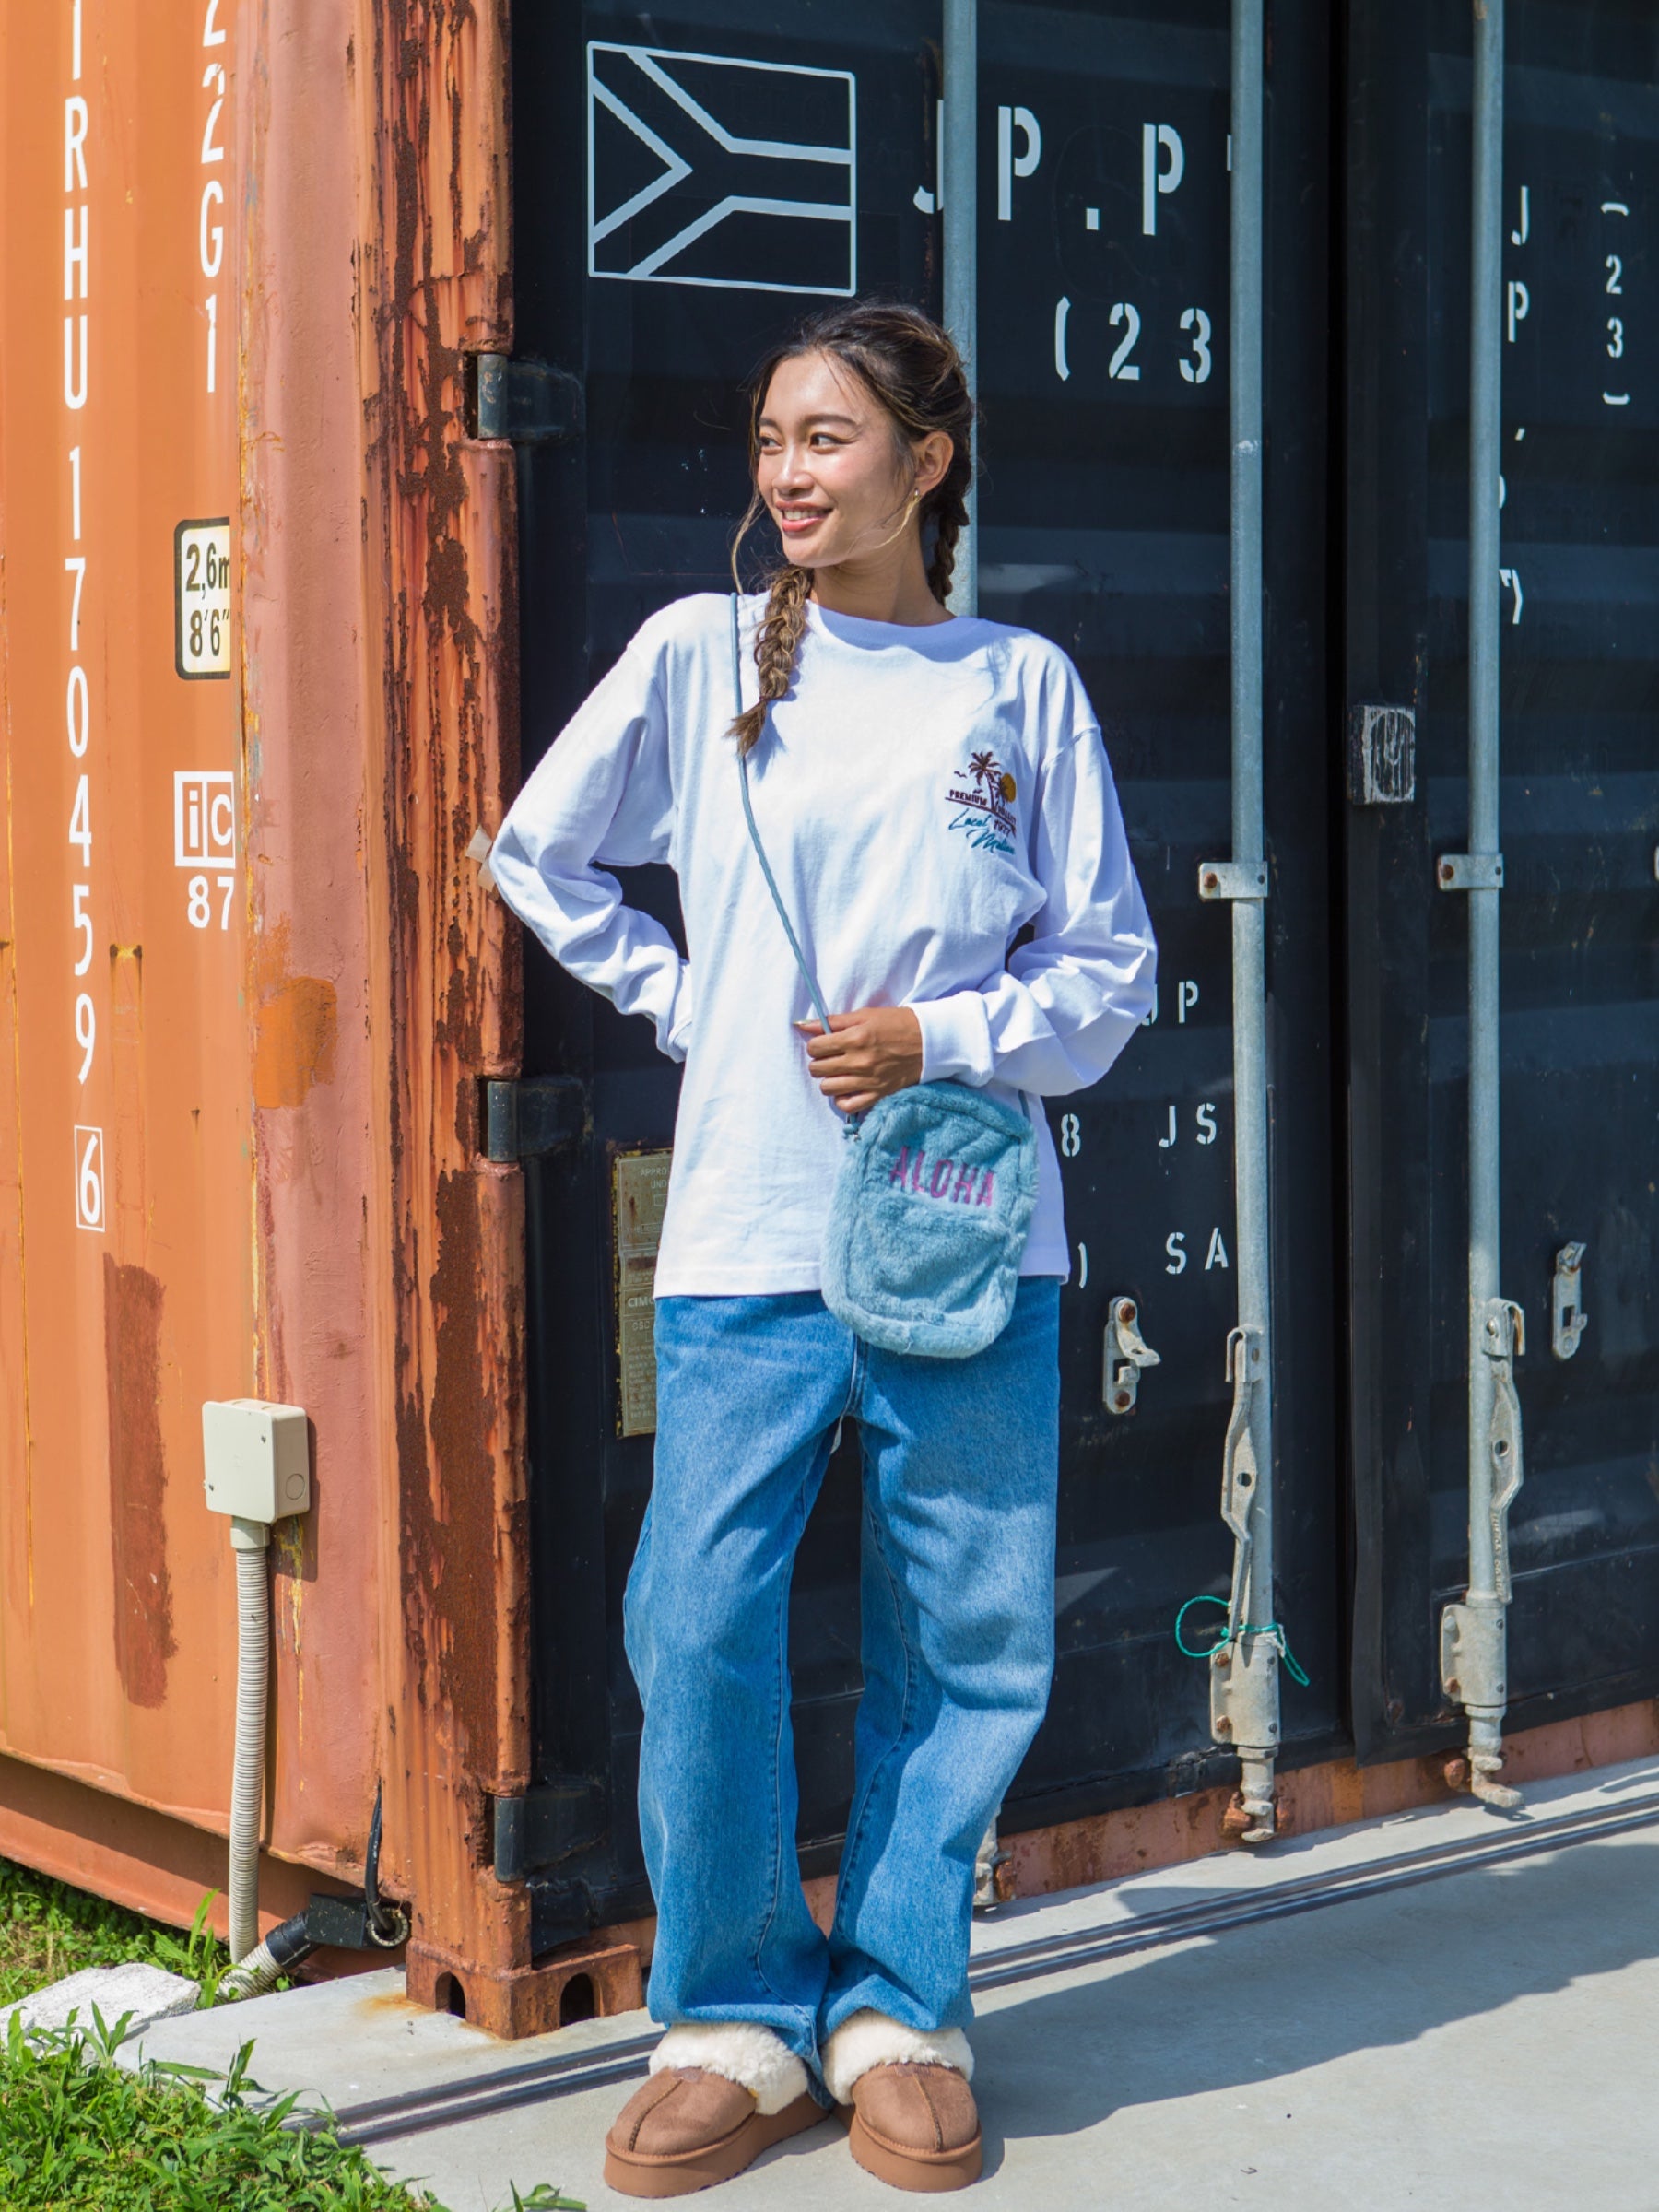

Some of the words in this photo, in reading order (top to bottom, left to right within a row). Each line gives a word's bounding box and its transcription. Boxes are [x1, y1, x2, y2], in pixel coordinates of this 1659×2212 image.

[65, 447, 96, 1085] 170459
[187, 875, 235, 931] 87
[79, 1134, 100, 1225] 6
[889, 1146, 995, 1209] ALOHA
